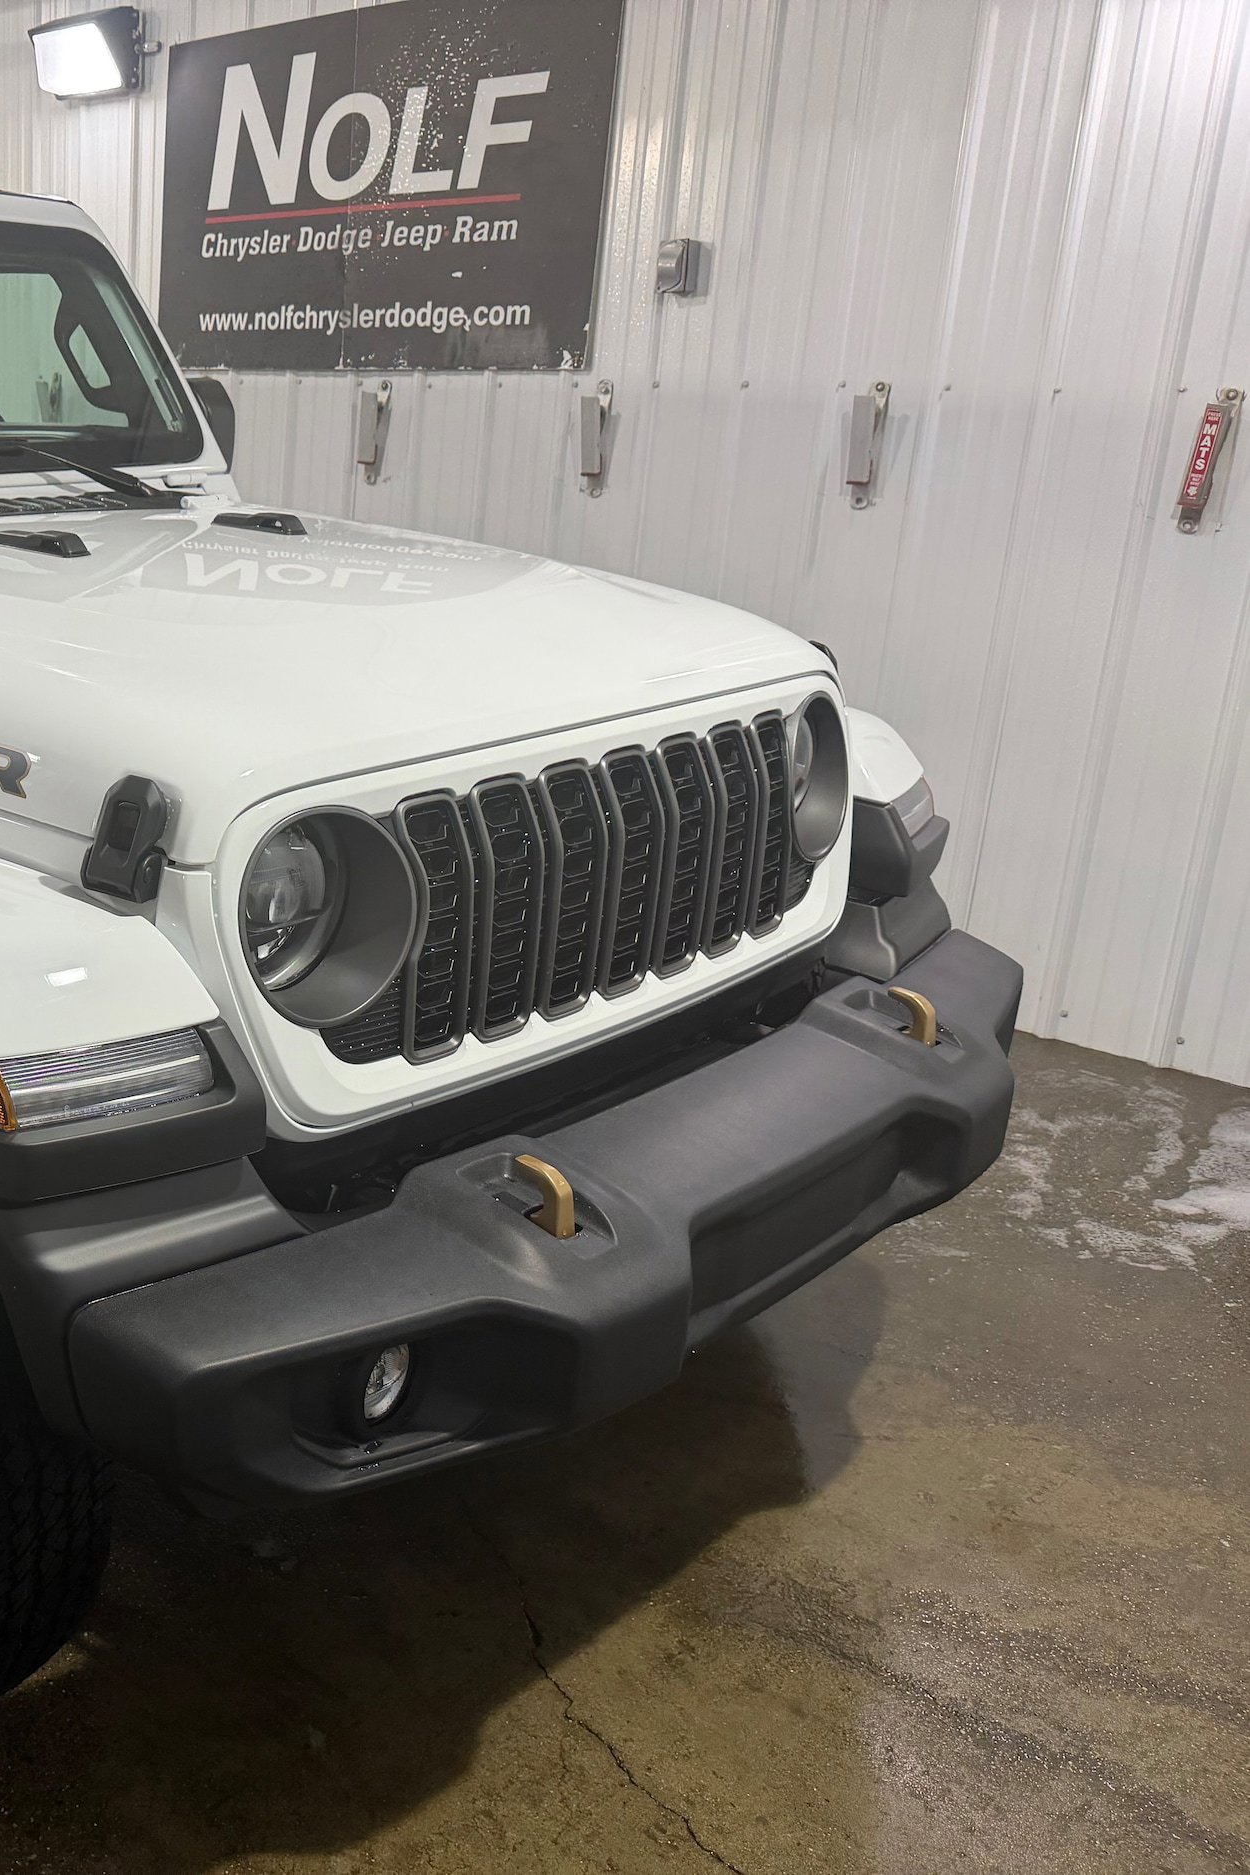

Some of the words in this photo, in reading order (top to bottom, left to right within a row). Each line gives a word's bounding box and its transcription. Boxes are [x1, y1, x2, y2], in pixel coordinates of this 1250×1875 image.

[201, 229, 290, 262] Chrysler
[297, 223, 372, 256] Dodge
[381, 220, 442, 252] Jeep
[452, 215, 518, 243] Ram
[199, 301, 531, 335] www.nolfchryslerdodge.com
[1194, 423, 1218, 470] MATS
